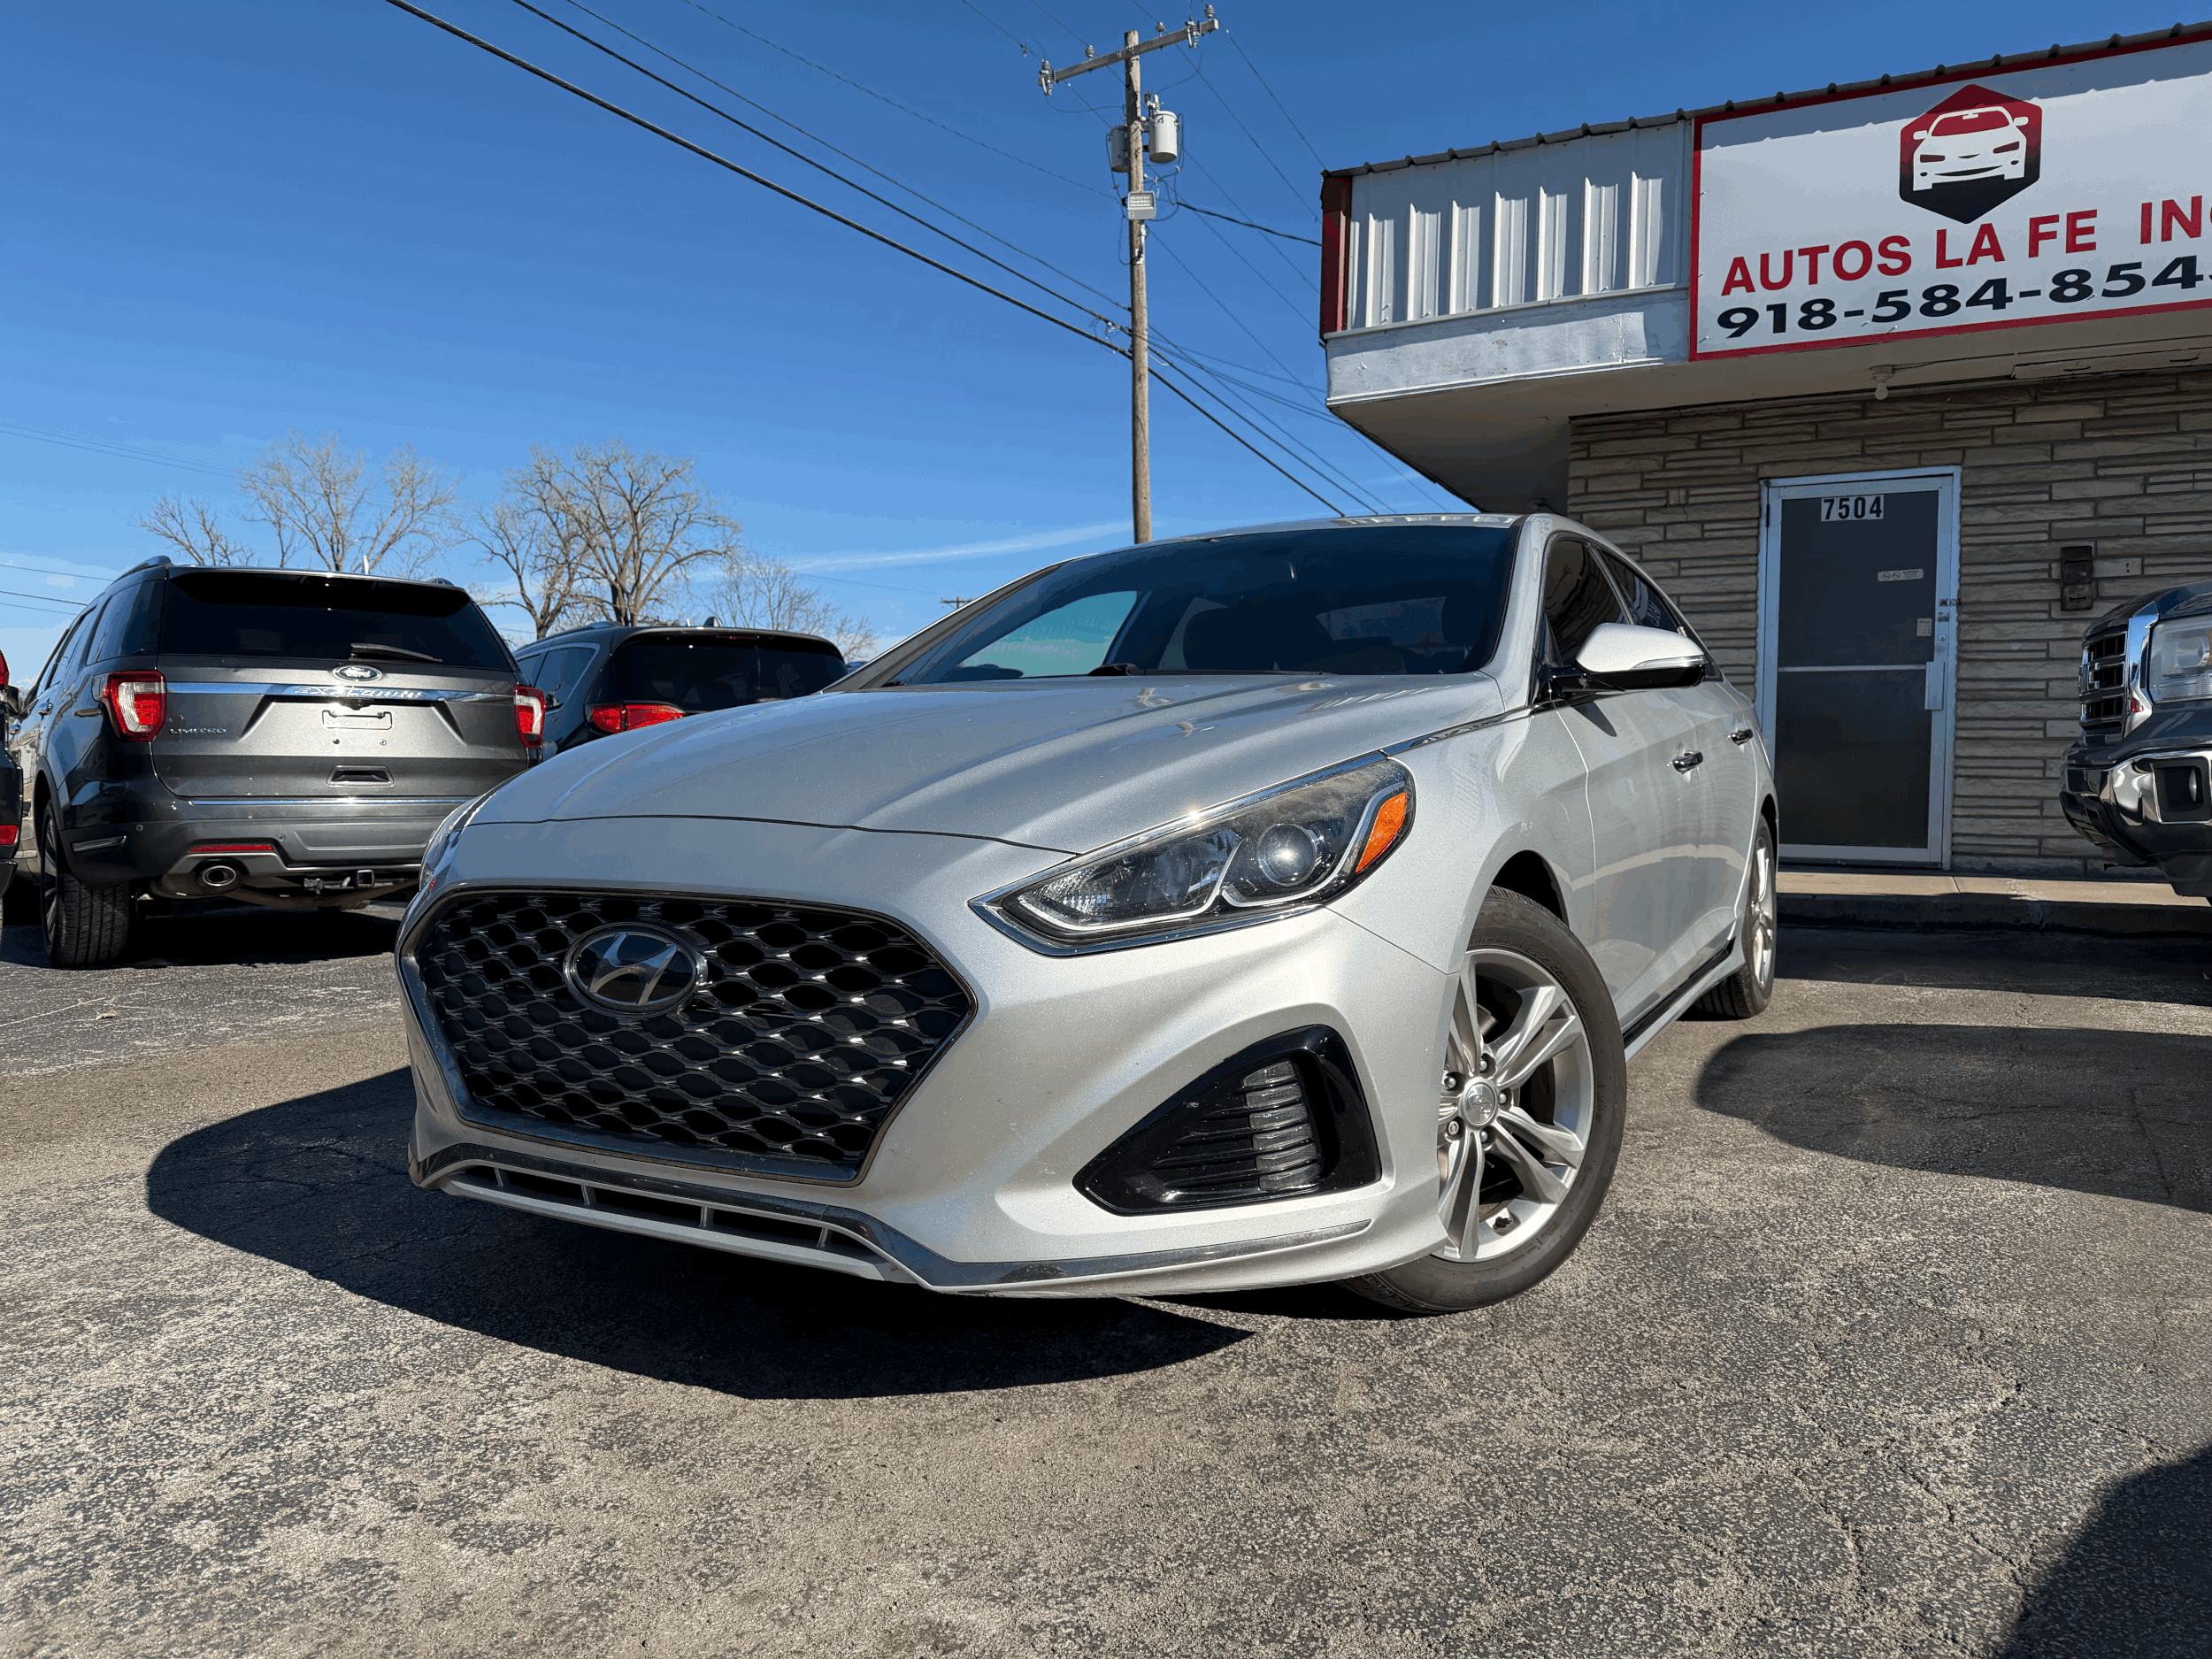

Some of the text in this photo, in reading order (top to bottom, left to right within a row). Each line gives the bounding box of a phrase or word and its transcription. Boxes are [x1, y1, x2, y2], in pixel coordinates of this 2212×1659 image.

[1721, 196, 2212, 296] AUTOS LA FE IN
[1717, 255, 2212, 339] 918-584-854
[1824, 495, 1882, 520] 7504
[343, 666, 372, 679] Ford
